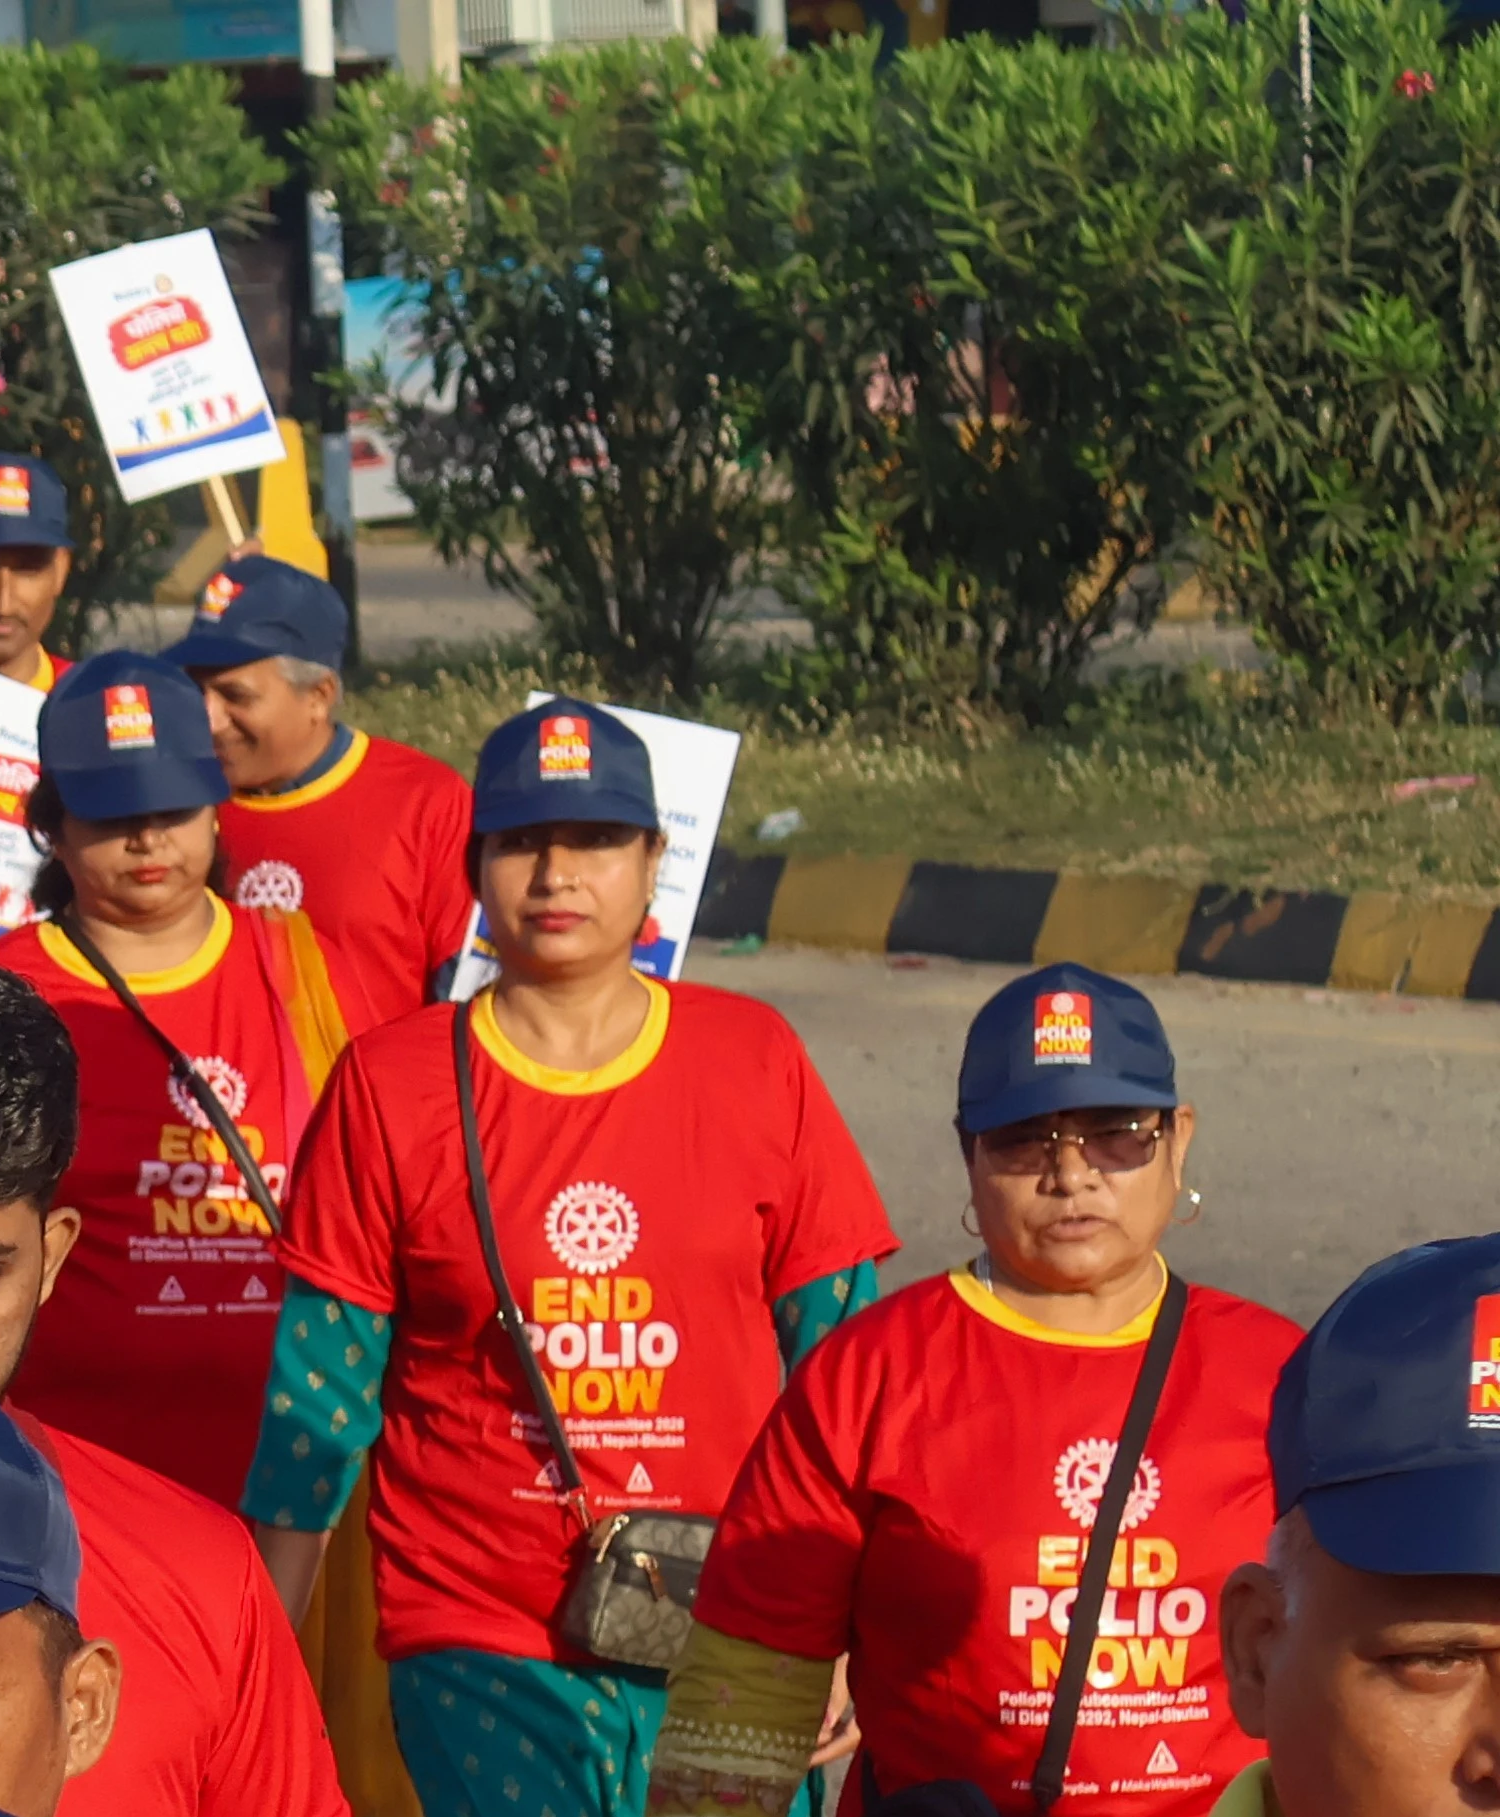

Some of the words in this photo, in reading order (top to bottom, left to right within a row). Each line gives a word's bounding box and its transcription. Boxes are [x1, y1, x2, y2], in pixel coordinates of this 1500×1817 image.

[534, 1276, 652, 1323] END
[524, 1322, 678, 1368] POLIO
[542, 1367, 664, 1414] NOW
[1010, 1587, 1206, 1636] POLIO
[1032, 1636, 1188, 1688] NOW
